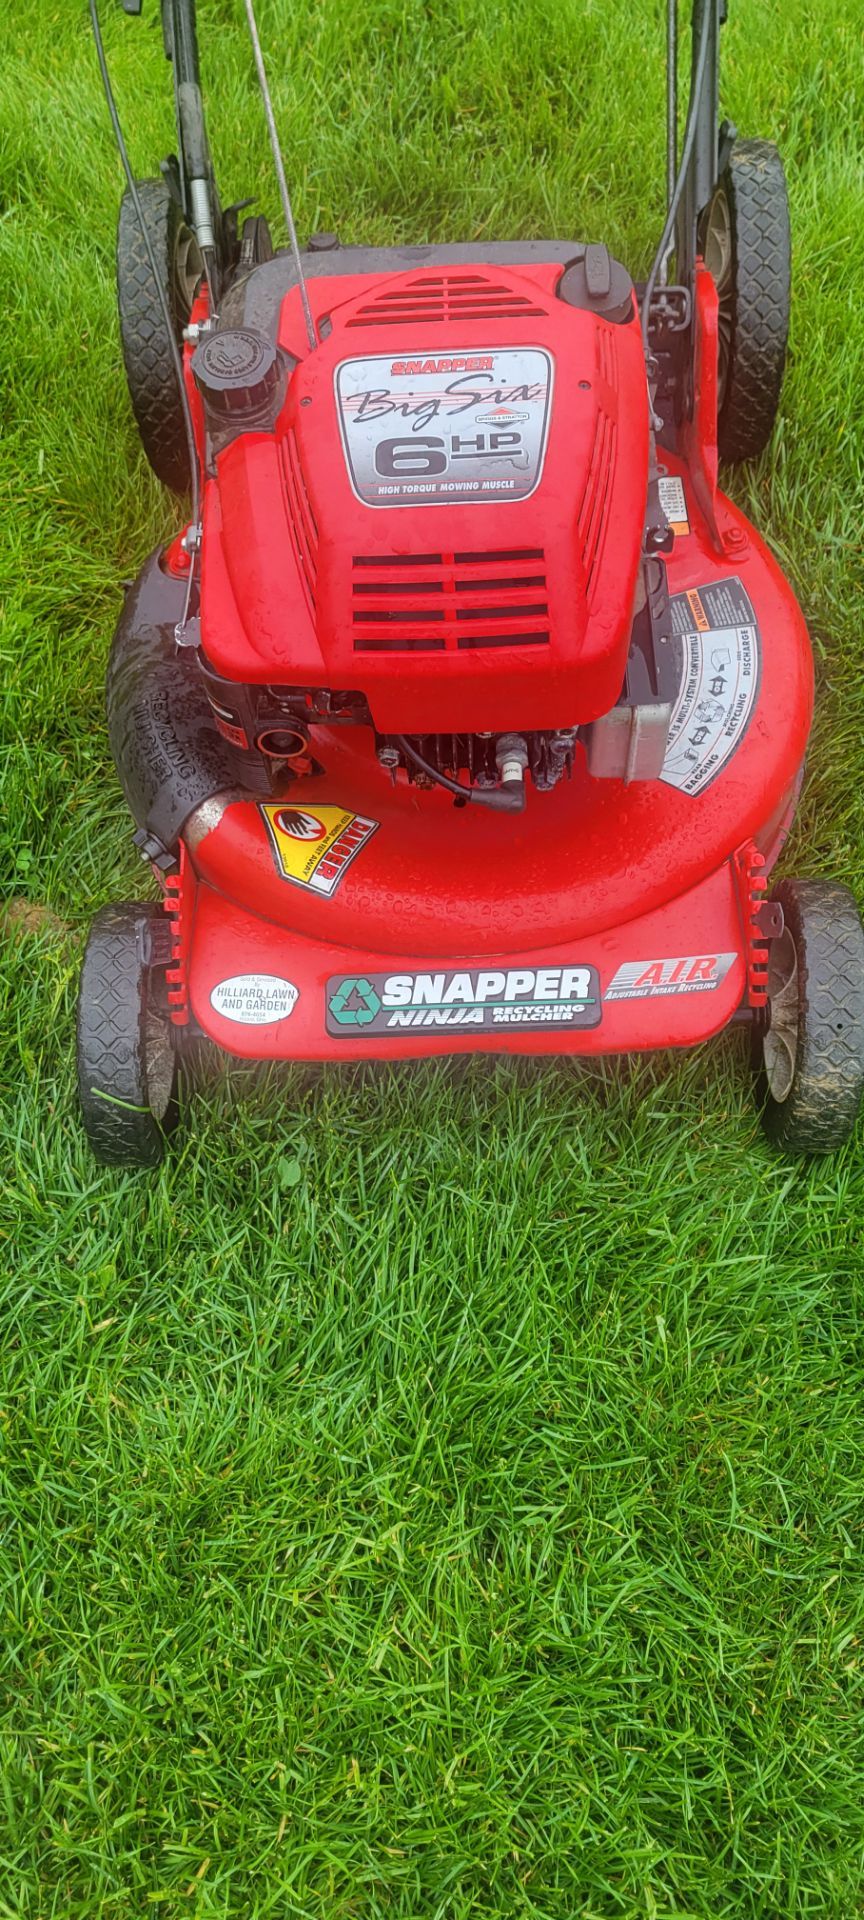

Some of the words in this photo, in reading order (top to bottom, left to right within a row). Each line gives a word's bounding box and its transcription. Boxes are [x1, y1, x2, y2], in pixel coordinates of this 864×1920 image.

[391, 356, 494, 376] SNAPPER
[346, 389, 440, 432] Big
[445, 374, 542, 415] Six
[374, 435, 448, 478] 6
[451, 432, 522, 452] HP
[378, 485, 400, 494] HIGH
[402, 484, 436, 493] TORQUE
[440, 481, 479, 491] MOWING
[482, 480, 515, 489] MUSCLE
[741, 630, 751, 676] DISCHARGE
[676, 678, 698, 724] MULTI-SYSTEM
[690, 635, 700, 676] CONVERTIBLE
[725, 693, 747, 737] RECYCLING
[150, 690, 196, 780] RECYCLING
[684, 754, 719, 790] BAGGING
[330, 824, 341, 837] HANDS
[341, 814, 351, 825] KEEP
[315, 821, 371, 880] DANGER
[316, 842, 327, 855] FEET
[302, 855, 317, 876] AWAY
[632, 957, 718, 988] A.I.R.
[217, 988, 263, 998] HILLIARD
[266, 989, 295, 999] LAWN
[382, 968, 591, 1006] SNAPPER
[604, 990, 648, 1000] ADJUSTABLE
[650, 986, 676, 995] INTAKE
[678, 982, 717, 992] RECYCLING
[222, 999, 242, 1009] AND
[246, 1000, 287, 1011] GARDEN
[386, 1008, 484, 1027] NINJA
[493, 1004, 585, 1015] RECYCLING
[493, 1012, 574, 1023] MULCHER
